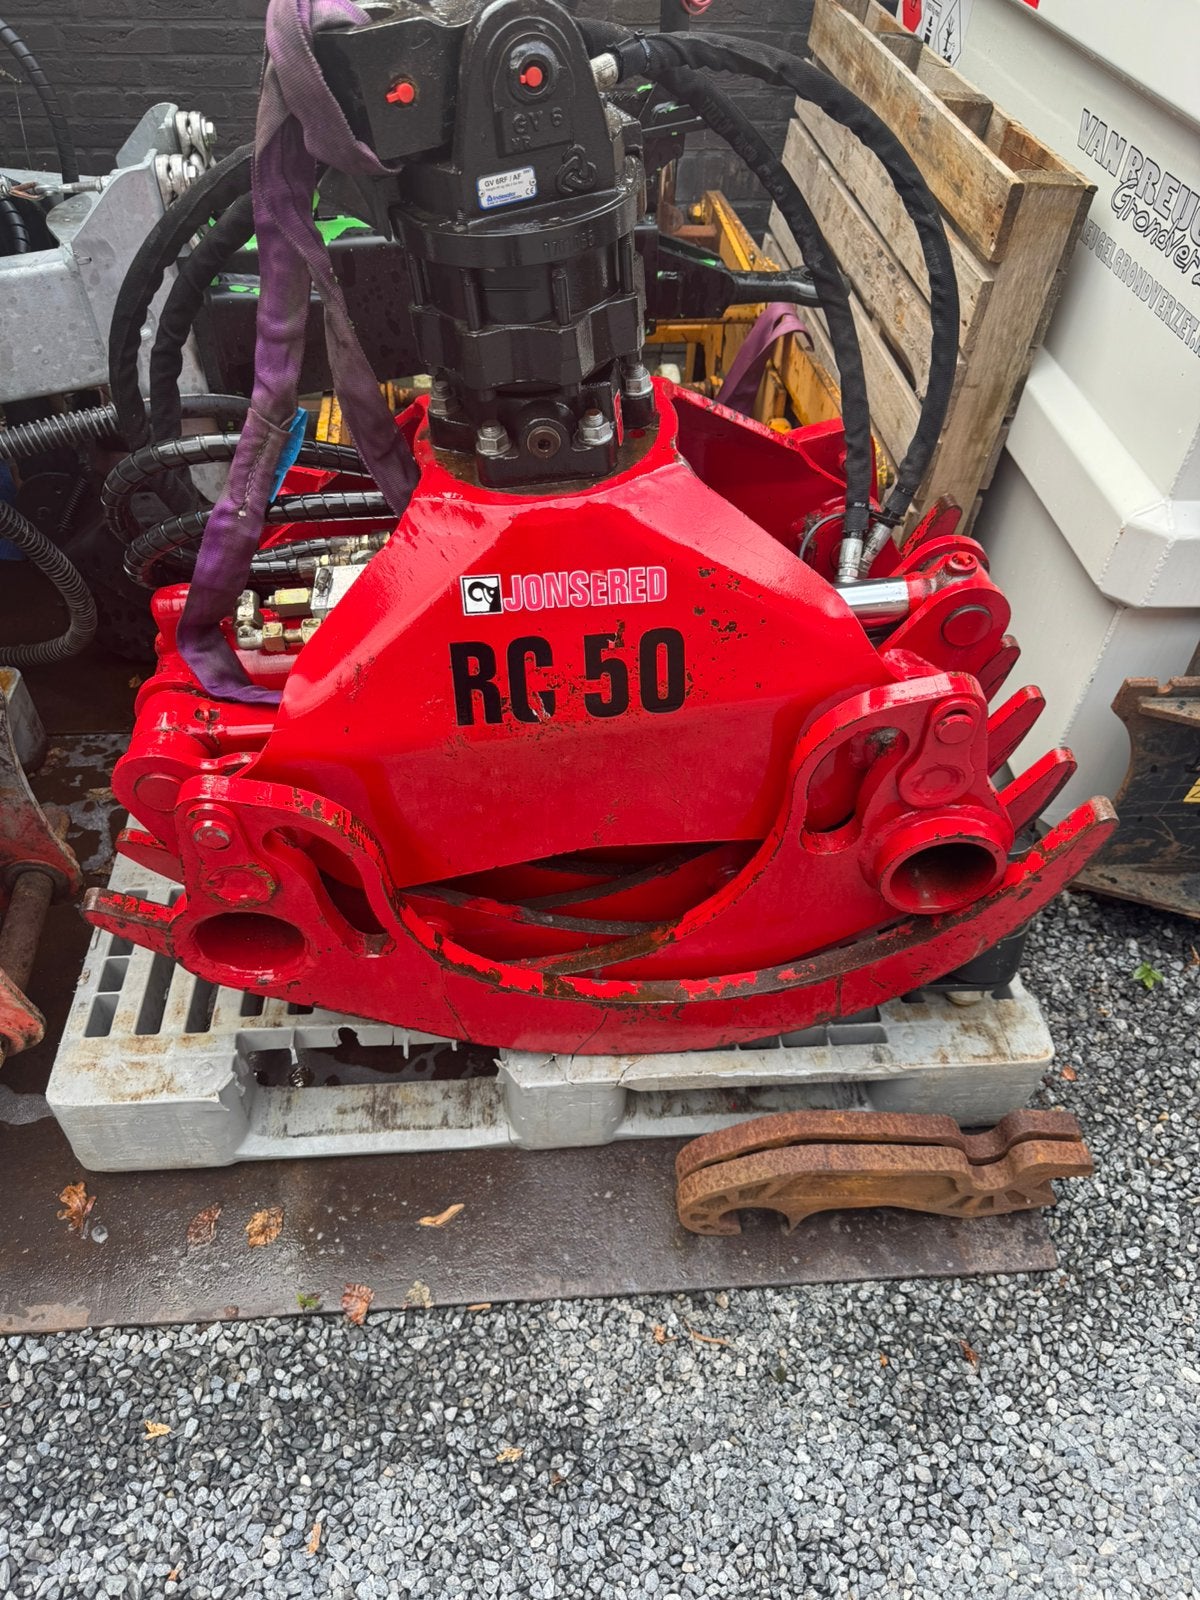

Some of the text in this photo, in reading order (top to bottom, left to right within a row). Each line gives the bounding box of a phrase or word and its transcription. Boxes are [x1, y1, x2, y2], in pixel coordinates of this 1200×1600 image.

[512, 106, 563, 135] GV 6
[484, 179, 495, 188] GV
[512, 173, 522, 181] AF
[1077, 107, 1200, 247] VAN BREU
[1111, 178, 1200, 286] Grondver
[503, 566, 668, 612] JONSERED
[448, 627, 687, 727] RC 50
